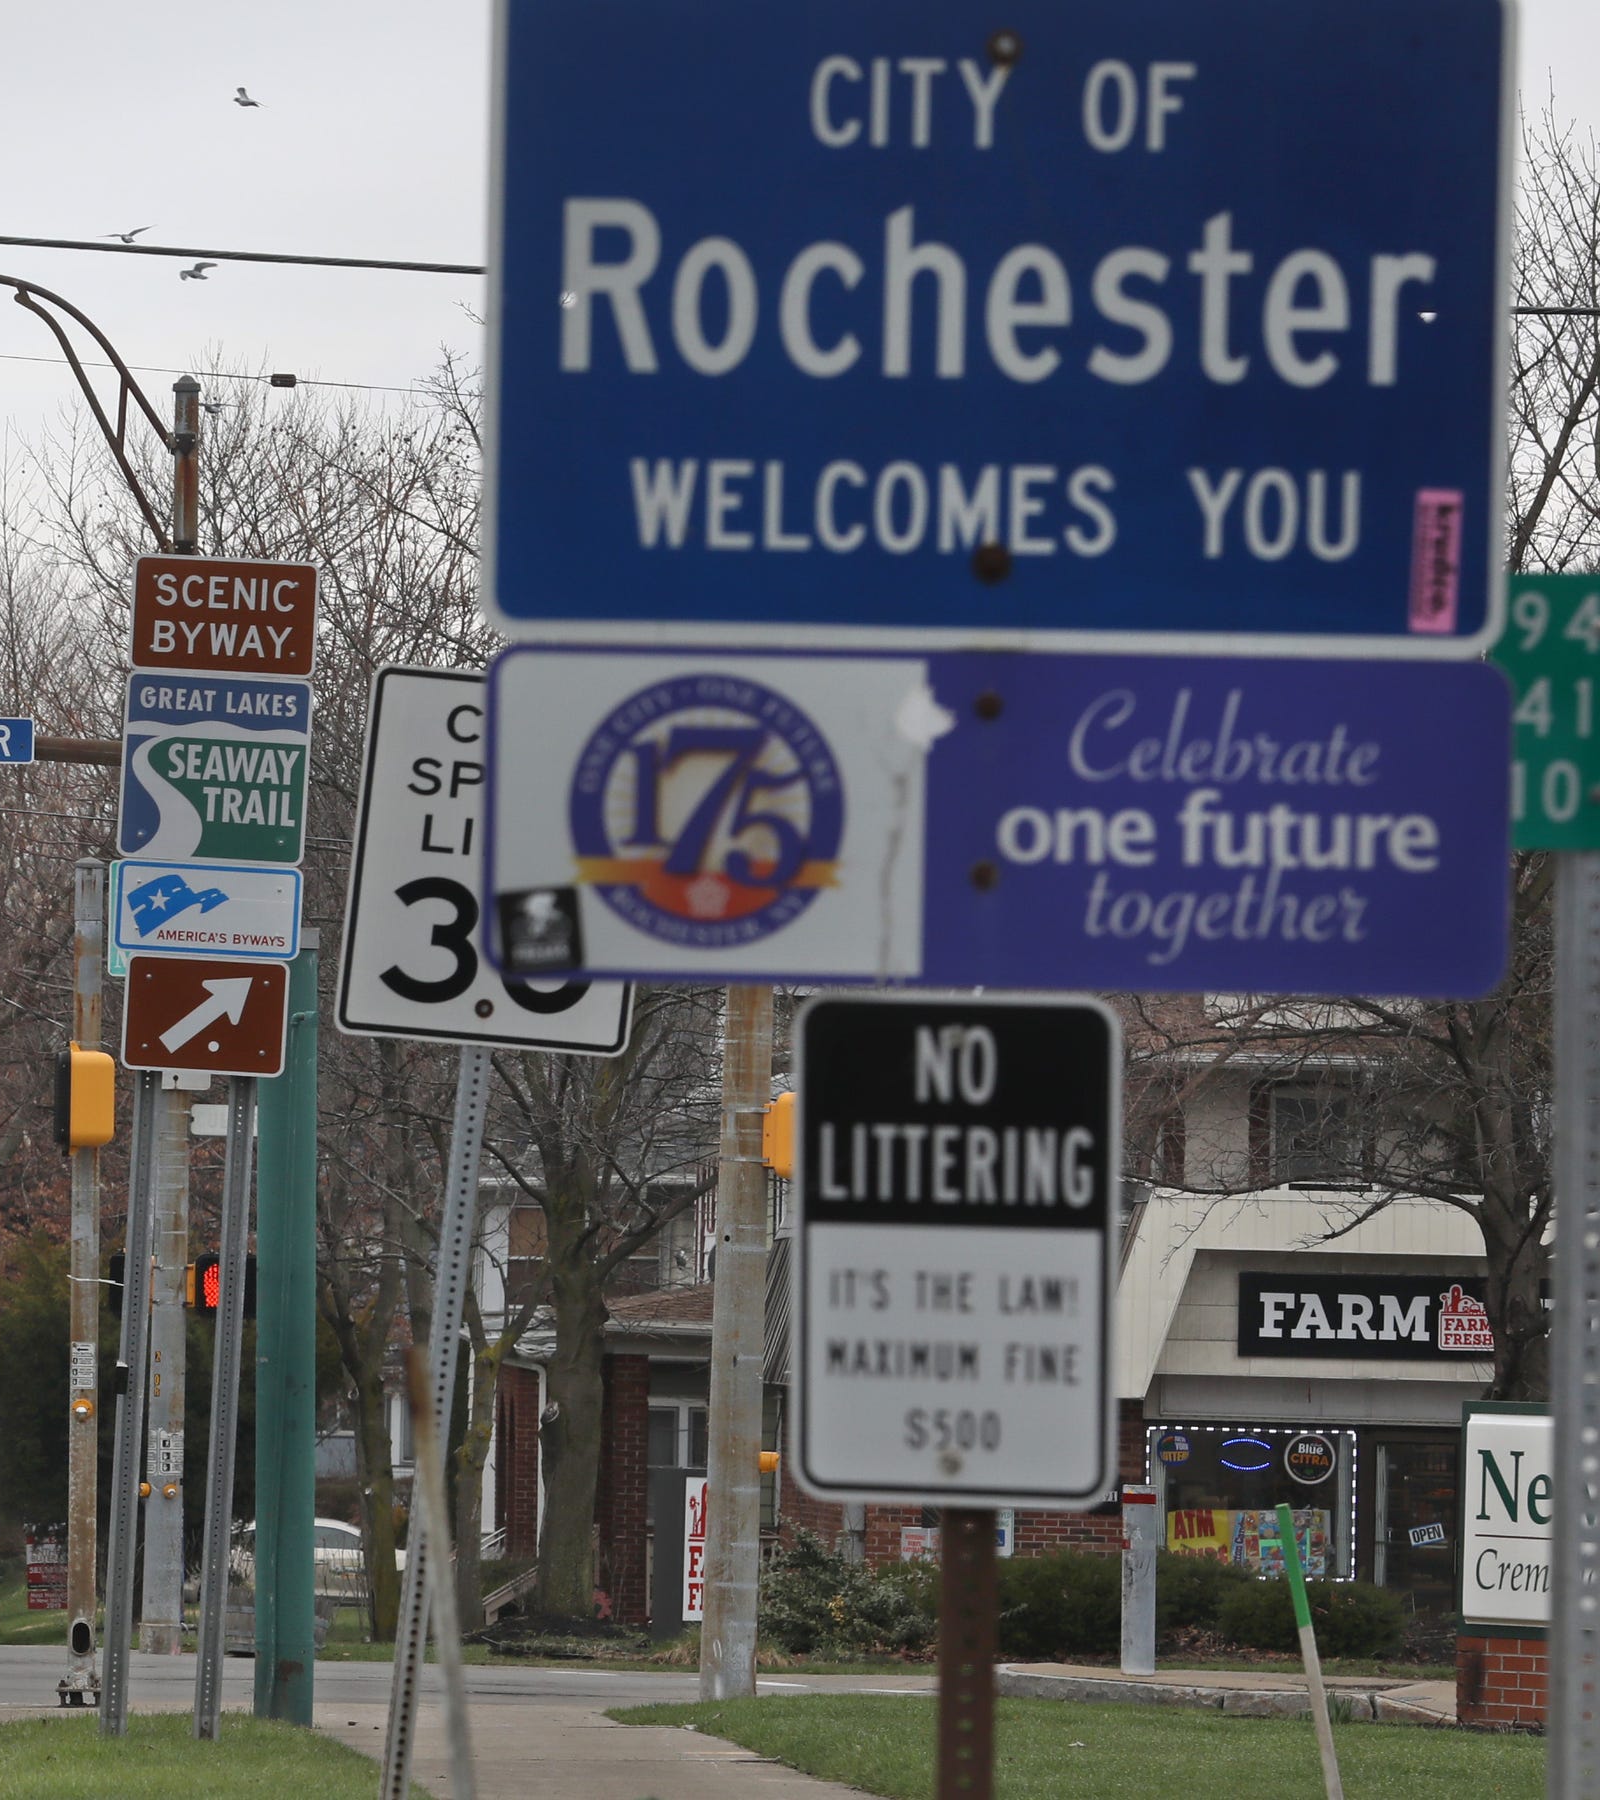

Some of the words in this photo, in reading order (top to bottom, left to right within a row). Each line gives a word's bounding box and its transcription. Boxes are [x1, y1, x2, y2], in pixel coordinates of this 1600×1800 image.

[811, 56, 1006, 149] CITY
[1082, 59, 1197, 152] OF
[559, 198, 1437, 388] Rochester
[631, 459, 1116, 558] WELCOMES
[1188, 469, 1361, 562] YOU
[155, 573, 299, 613] SCENIC
[149, 619, 293, 659] BYWAY
[140, 686, 217, 712] GREAT
[225, 691, 298, 718] LAKES
[1069, 688, 1380, 786] Celebrate
[167, 743, 300, 786] SEAWAY
[203, 786, 296, 828] TRAIL
[618, 724, 814, 888] 175
[998, 806, 1156, 865] one
[1178, 789, 1439, 873] future
[157, 929, 227, 945] AMERICA'S
[232, 933, 286, 948] BYWAYS
[1084, 867, 1368, 966] together
[916, 1026, 996, 1105] NO
[820, 1123, 1094, 1208] LITTERING
[828, 1267, 892, 1312] IT'S
[913, 1268, 976, 1315] THE
[998, 1271, 1079, 1318] LAW!
[1258, 1292, 1431, 1342] FARM
[1444, 1318, 1493, 1331] FARM
[1444, 1333, 1493, 1345] FRESH
[825, 1338, 981, 1382] MAXIMUM
[1003, 1341, 1080, 1388] FINE
[904, 1408, 1003, 1452] $500
[1298, 1443, 1324, 1455] Blue
[1290, 1454, 1330, 1467] CITRA
[1174, 1509, 1216, 1540] ATM
[1411, 1525, 1442, 1543] OPEN
